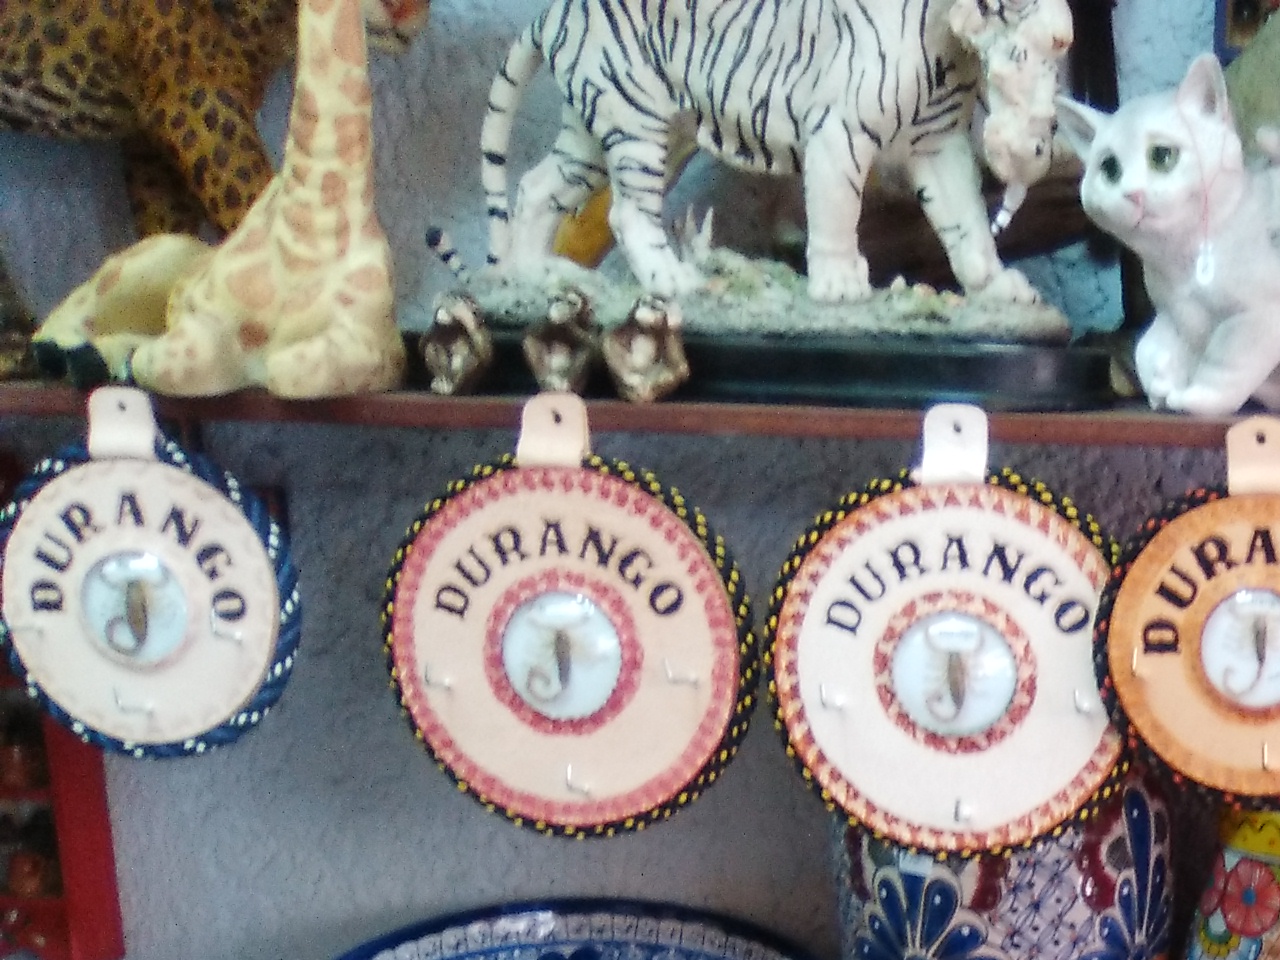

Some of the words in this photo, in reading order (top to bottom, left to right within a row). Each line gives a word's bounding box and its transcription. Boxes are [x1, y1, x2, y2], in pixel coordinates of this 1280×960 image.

[31, 492, 248, 622] DURANGO
[434, 518, 685, 619] DURANGO
[826, 534, 1090, 636] DURANGO
